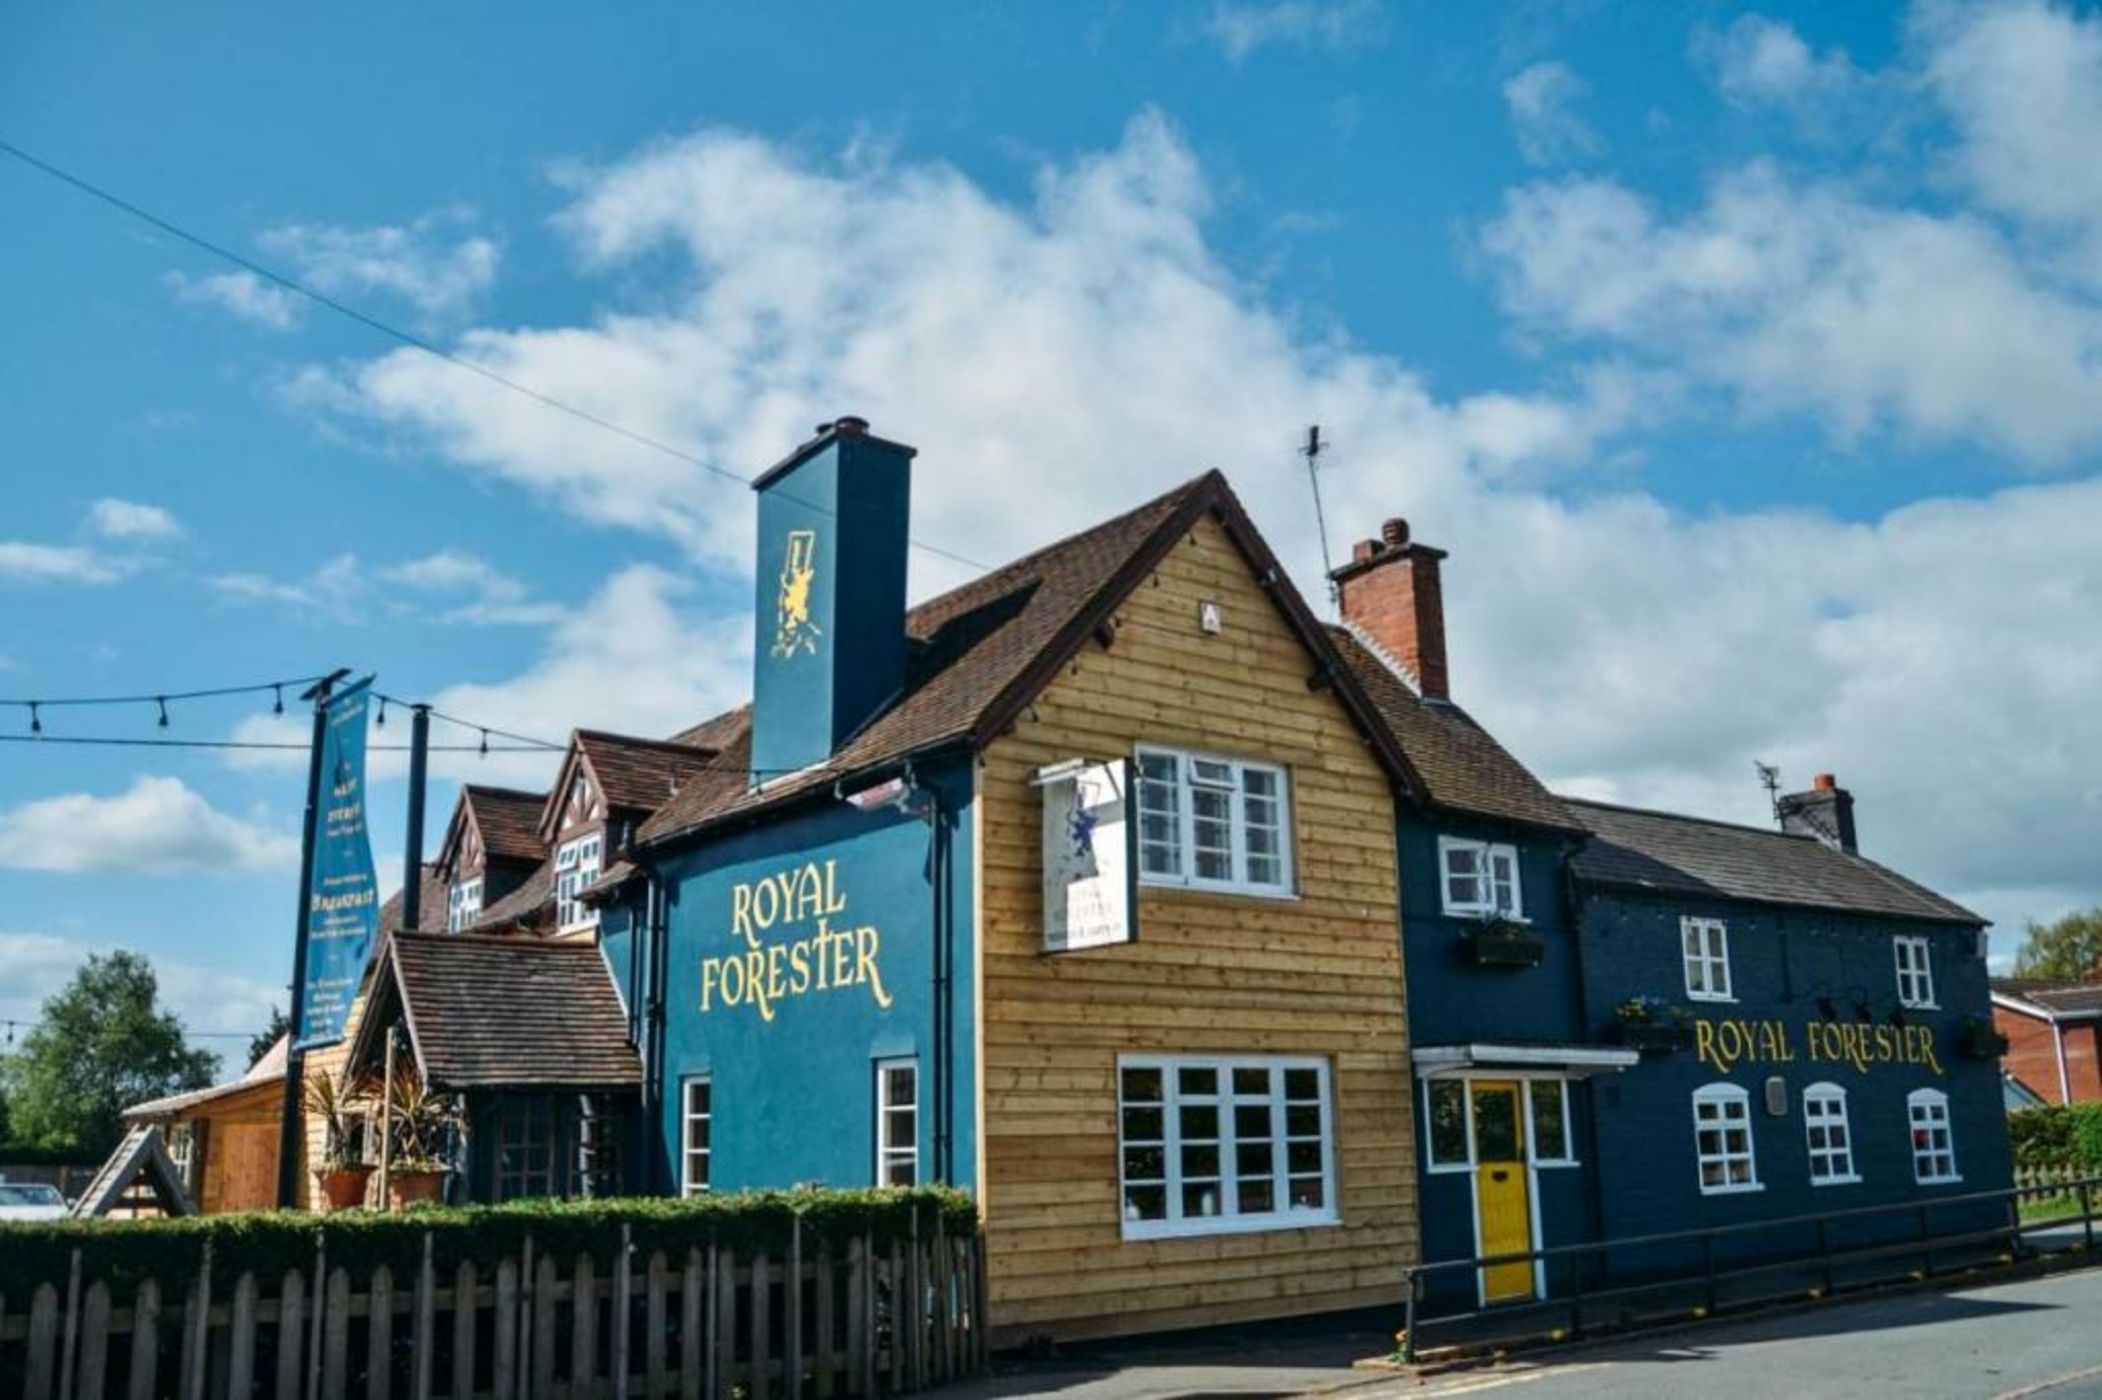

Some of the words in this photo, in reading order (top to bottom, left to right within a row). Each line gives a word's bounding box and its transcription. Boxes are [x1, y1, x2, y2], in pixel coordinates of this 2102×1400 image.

[731, 858, 848, 948] ROYAL
[699, 918, 894, 1022] FORESTER
[1695, 1019, 1795, 1075] ROYAL
[1807, 1021, 1945, 1076] FORESTER
